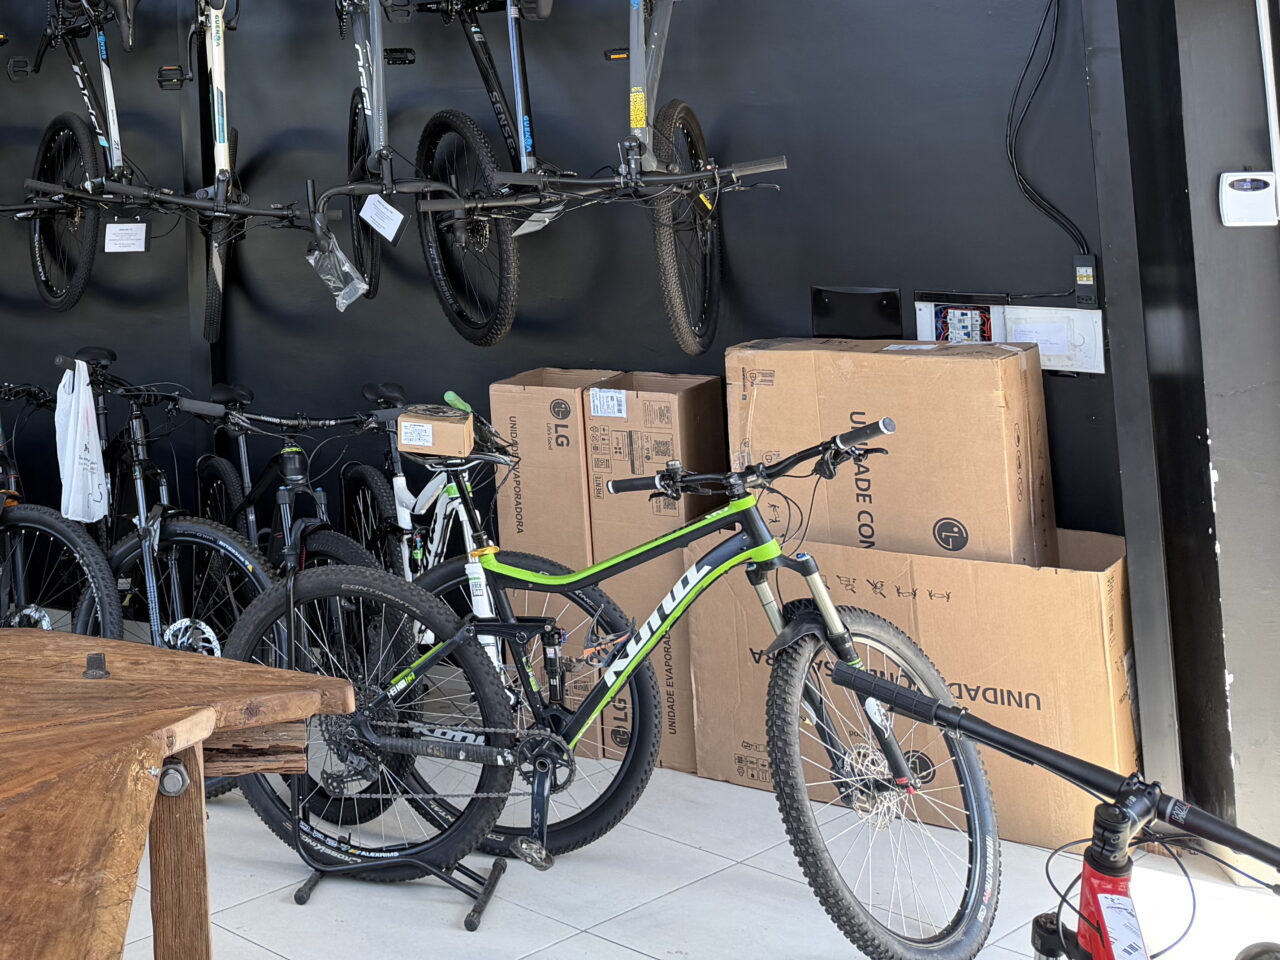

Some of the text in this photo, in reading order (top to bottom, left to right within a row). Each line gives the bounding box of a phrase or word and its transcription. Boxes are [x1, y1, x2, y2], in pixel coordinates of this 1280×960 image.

[213, 14, 221, 47] GUENOA
[489, 91, 516, 148] SENSE
[523, 115, 533, 152] GUENOA
[509, 415, 519, 457] UNIDADE
[554, 423, 570, 448] LG
[849, 411, 872, 504] UADE
[594, 475, 603, 499] FRENTE
[663, 633, 677, 735] UNIDADE EVAPORAD
[950, 680, 1042, 710] UNIDAD
[612, 697, 628, 722] LG
